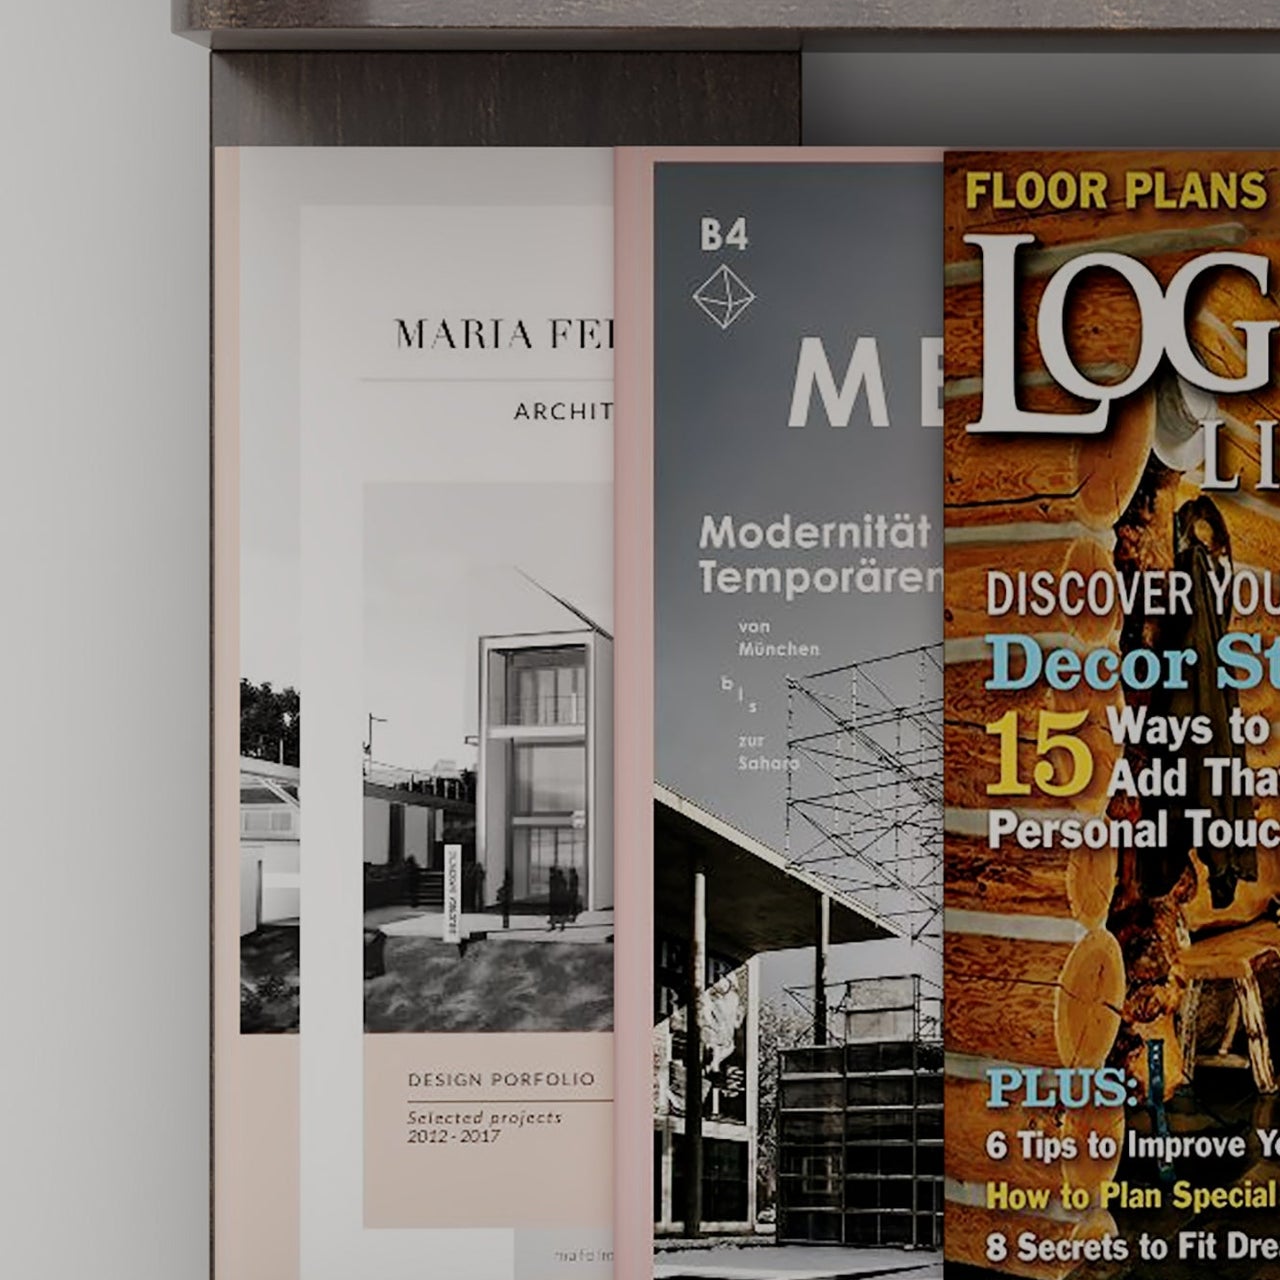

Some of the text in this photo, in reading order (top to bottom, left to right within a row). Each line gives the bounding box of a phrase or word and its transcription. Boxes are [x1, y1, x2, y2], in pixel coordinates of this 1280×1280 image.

[965, 172, 1107, 210] FLOOR
[1125, 172, 1267, 210] PLANS
[701, 217, 749, 251] B4
[397, 319, 532, 349] MARIA
[512, 400, 613, 422] ARCHIT
[699, 514, 932, 551] Modernität
[699, 558, 943, 601] Temporären
[987, 571, 1193, 617] DISCOVER
[739, 621, 770, 633] von
[739, 641, 820, 656] München
[984, 634, 1198, 690] Decor
[738, 736, 765, 747] zur
[1107, 706, 1270, 751] Ways to
[738, 755, 800, 770] Sahara
[984, 708, 1094, 798] 15
[1107, 758, 1188, 798] Add
[988, 809, 1168, 850] Personal
[409, 1072, 595, 1087] DESIGN PORFOLIO
[986, 1068, 1139, 1108] PLUS:
[407, 1110, 562, 1128] Selected projects
[986, 1131, 1007, 1158] 6
[1018, 1131, 1077, 1164] Tips
[1088, 1133, 1117, 1159] to
[1128, 1131, 1246, 1163] Improve
[986, 1182, 1050, 1209] How
[1061, 1184, 1090, 1209] to
[1100, 1180, 1163, 1209] Plan
[1172, 1180, 1276, 1213] Special
[986, 1234, 1007, 1261] 8
[1018, 1232, 1129, 1261] Secrets
[1139, 1235, 1168, 1261] to
[1179, 1231, 1217, 1260] Fit
